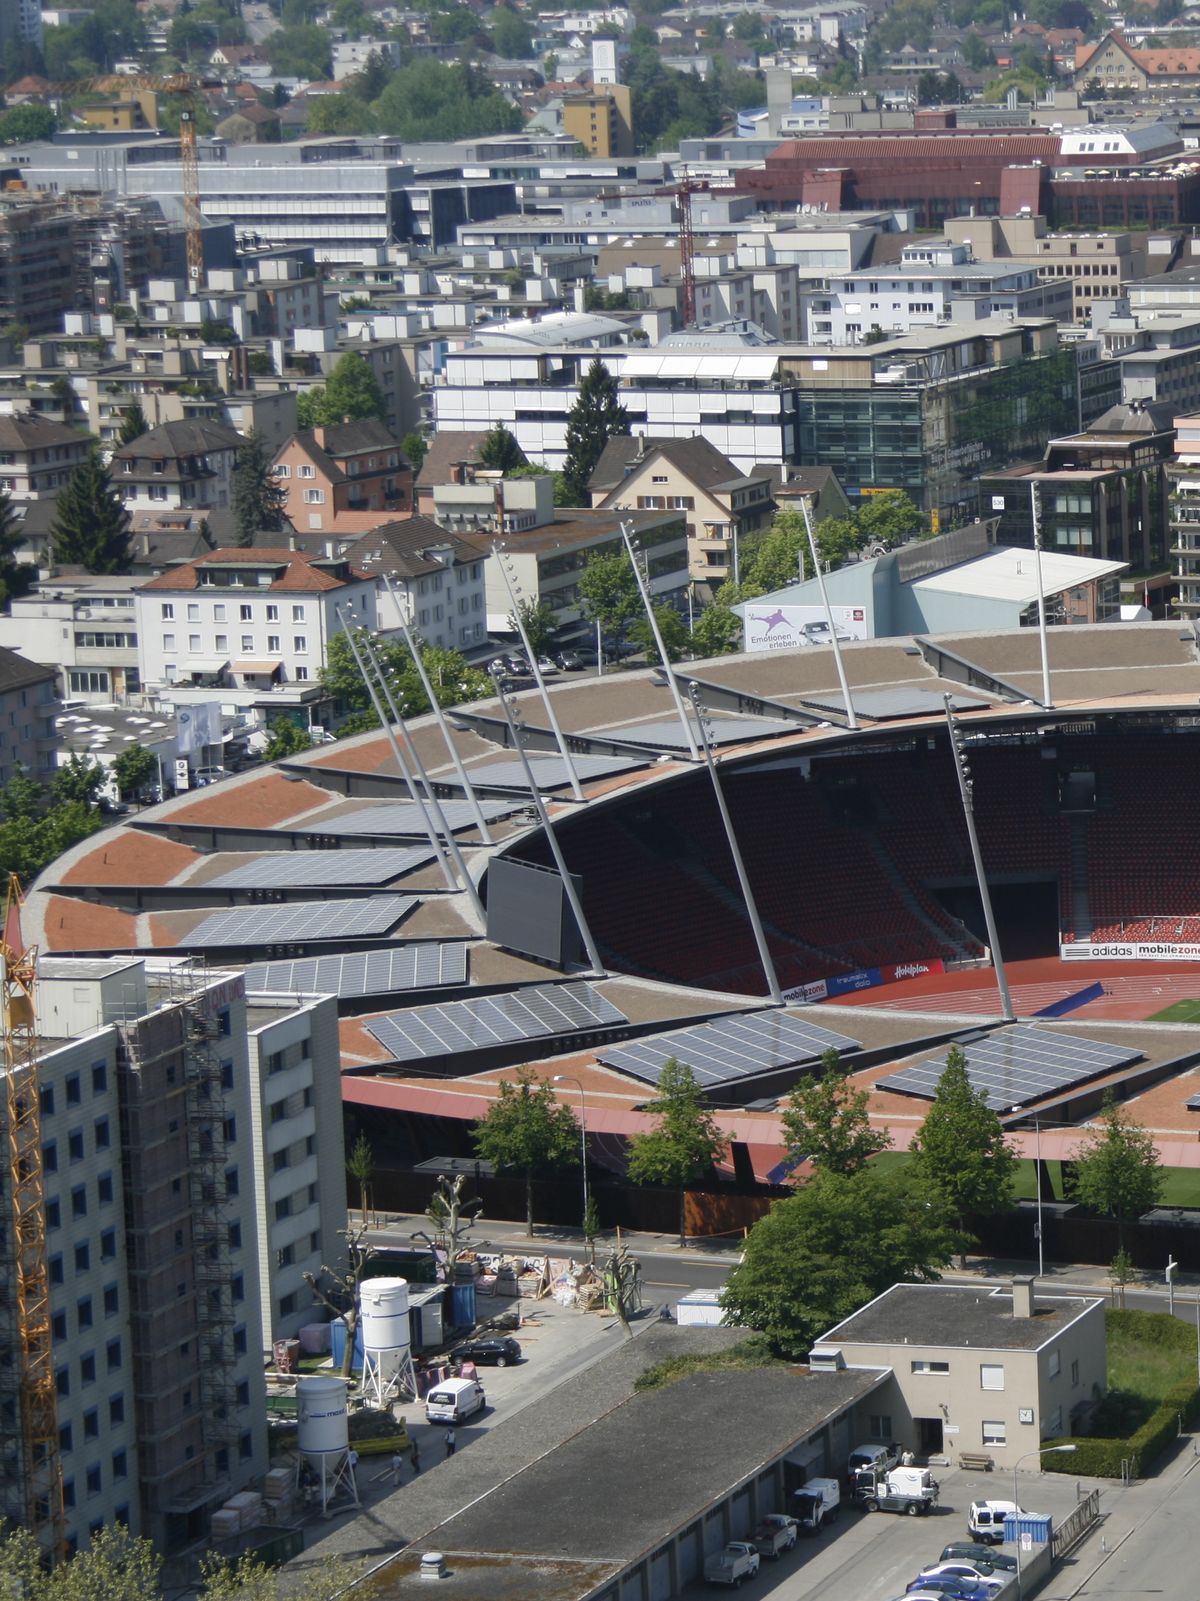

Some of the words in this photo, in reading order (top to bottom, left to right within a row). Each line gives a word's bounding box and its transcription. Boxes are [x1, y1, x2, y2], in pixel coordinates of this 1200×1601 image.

[751, 633, 792, 644] Emotionen
[769, 641, 797, 649] erleben
[1092, 946, 1133, 956] adidas
[895, 964, 929, 979] Hotelplan
[783, 984, 825, 1000] mobilezone
